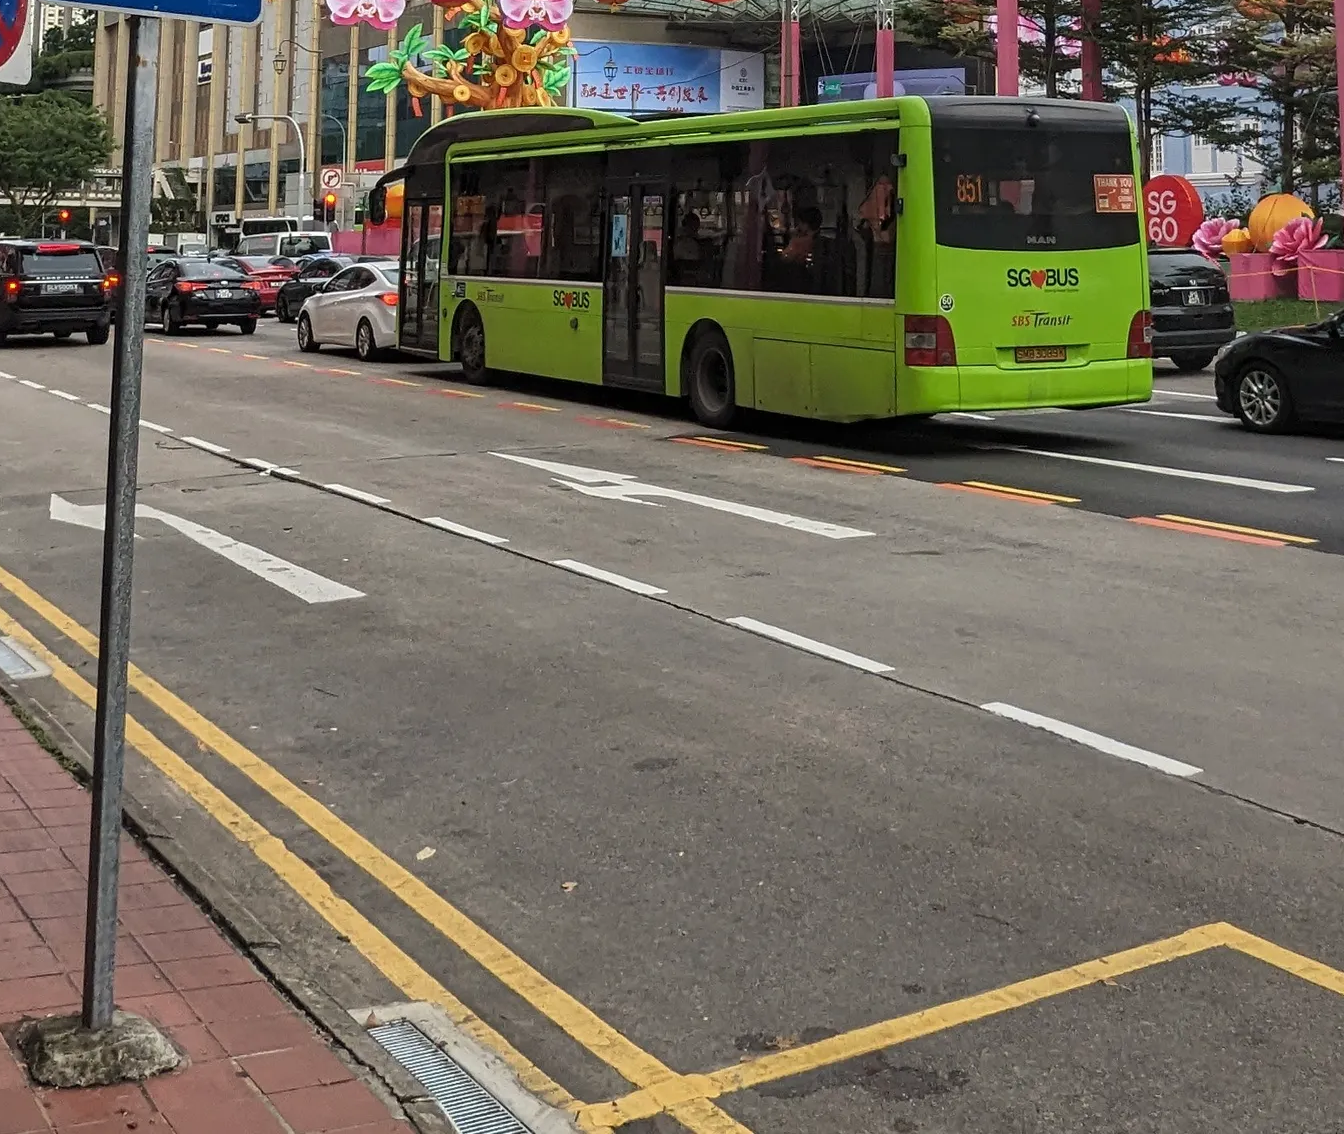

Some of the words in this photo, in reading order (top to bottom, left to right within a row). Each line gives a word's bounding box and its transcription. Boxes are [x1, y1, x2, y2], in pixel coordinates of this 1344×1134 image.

[957, 174, 983, 203] 851
[1096, 177, 1118, 187] THANK
[1119, 177, 1133, 187] YOU
[1147, 190, 1176, 215] SG
[1148, 216, 1178, 243] 60
[1027, 236, 1056, 244] MAN
[1011, 315, 1031, 327] SBS
[1030, 312, 1073, 328] Transit
